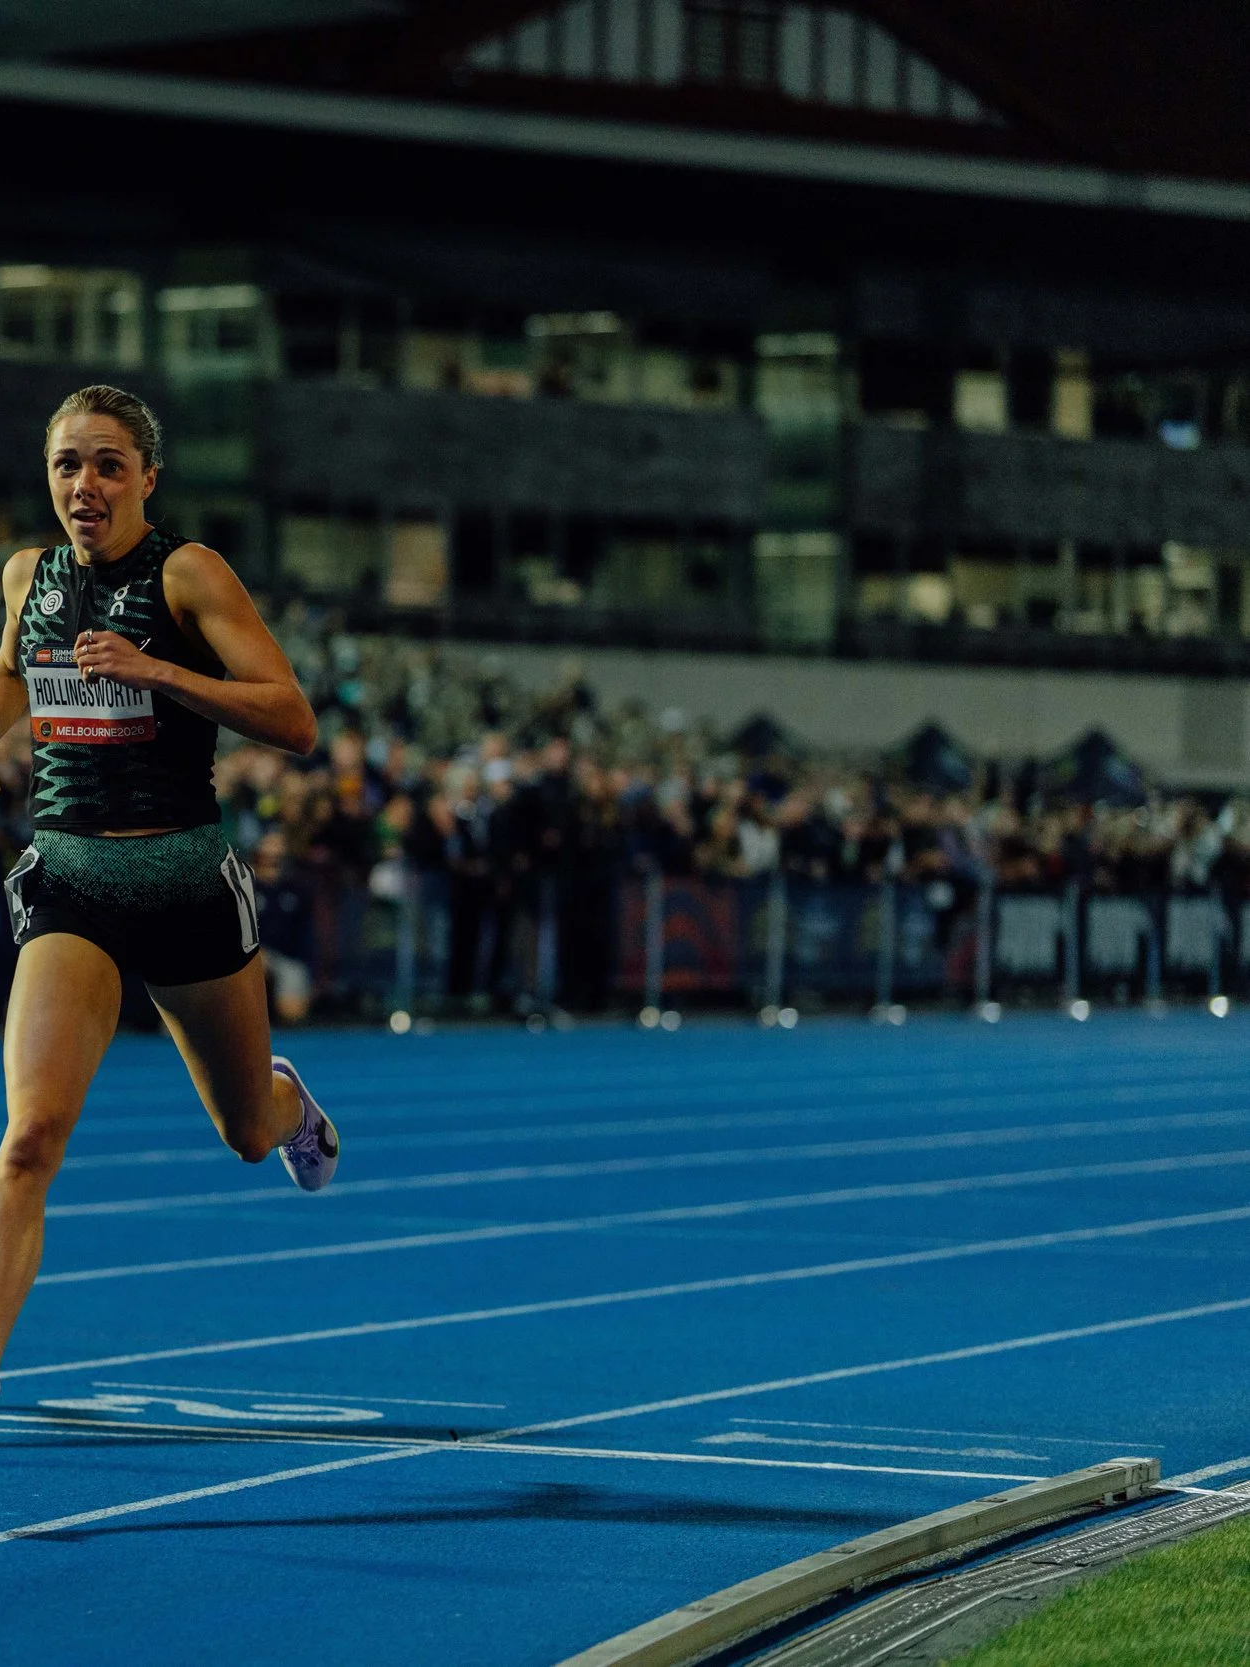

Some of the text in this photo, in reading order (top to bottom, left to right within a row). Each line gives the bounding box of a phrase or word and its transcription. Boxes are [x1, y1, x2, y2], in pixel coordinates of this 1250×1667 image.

[52, 649, 76, 657] SUMME
[33, 677, 144, 708] HOLLINGSWORTH
[56, 725, 145, 737] MELBOURNE2026
